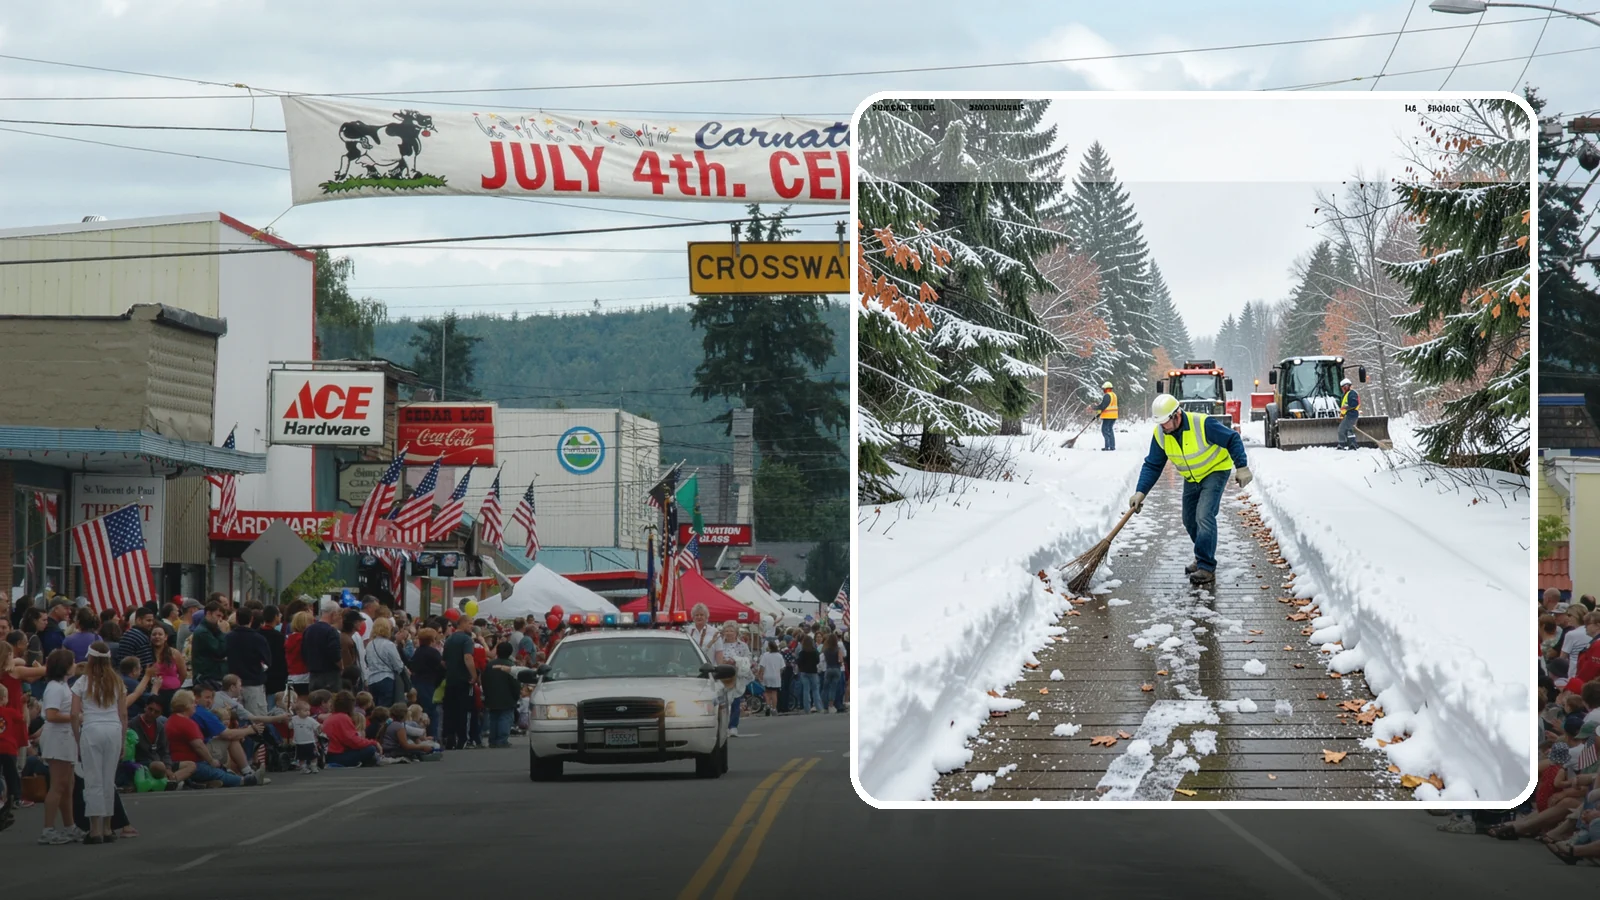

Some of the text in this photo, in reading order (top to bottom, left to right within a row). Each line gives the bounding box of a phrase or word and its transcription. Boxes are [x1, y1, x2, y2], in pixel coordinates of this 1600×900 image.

[695, 121, 850, 150] Carnat
[481, 141, 604, 192] JULY
[632, 150, 746, 198] 4th.
[697, 254, 850, 280] CROSSWA
[282, 380, 373, 419] ACE
[406, 409, 485, 421] CEDAR LOG
[283, 420, 371, 436] Hardware
[83, 485, 155, 495] St. Vincent de Paul
[699, 535, 730, 543] GLASS
